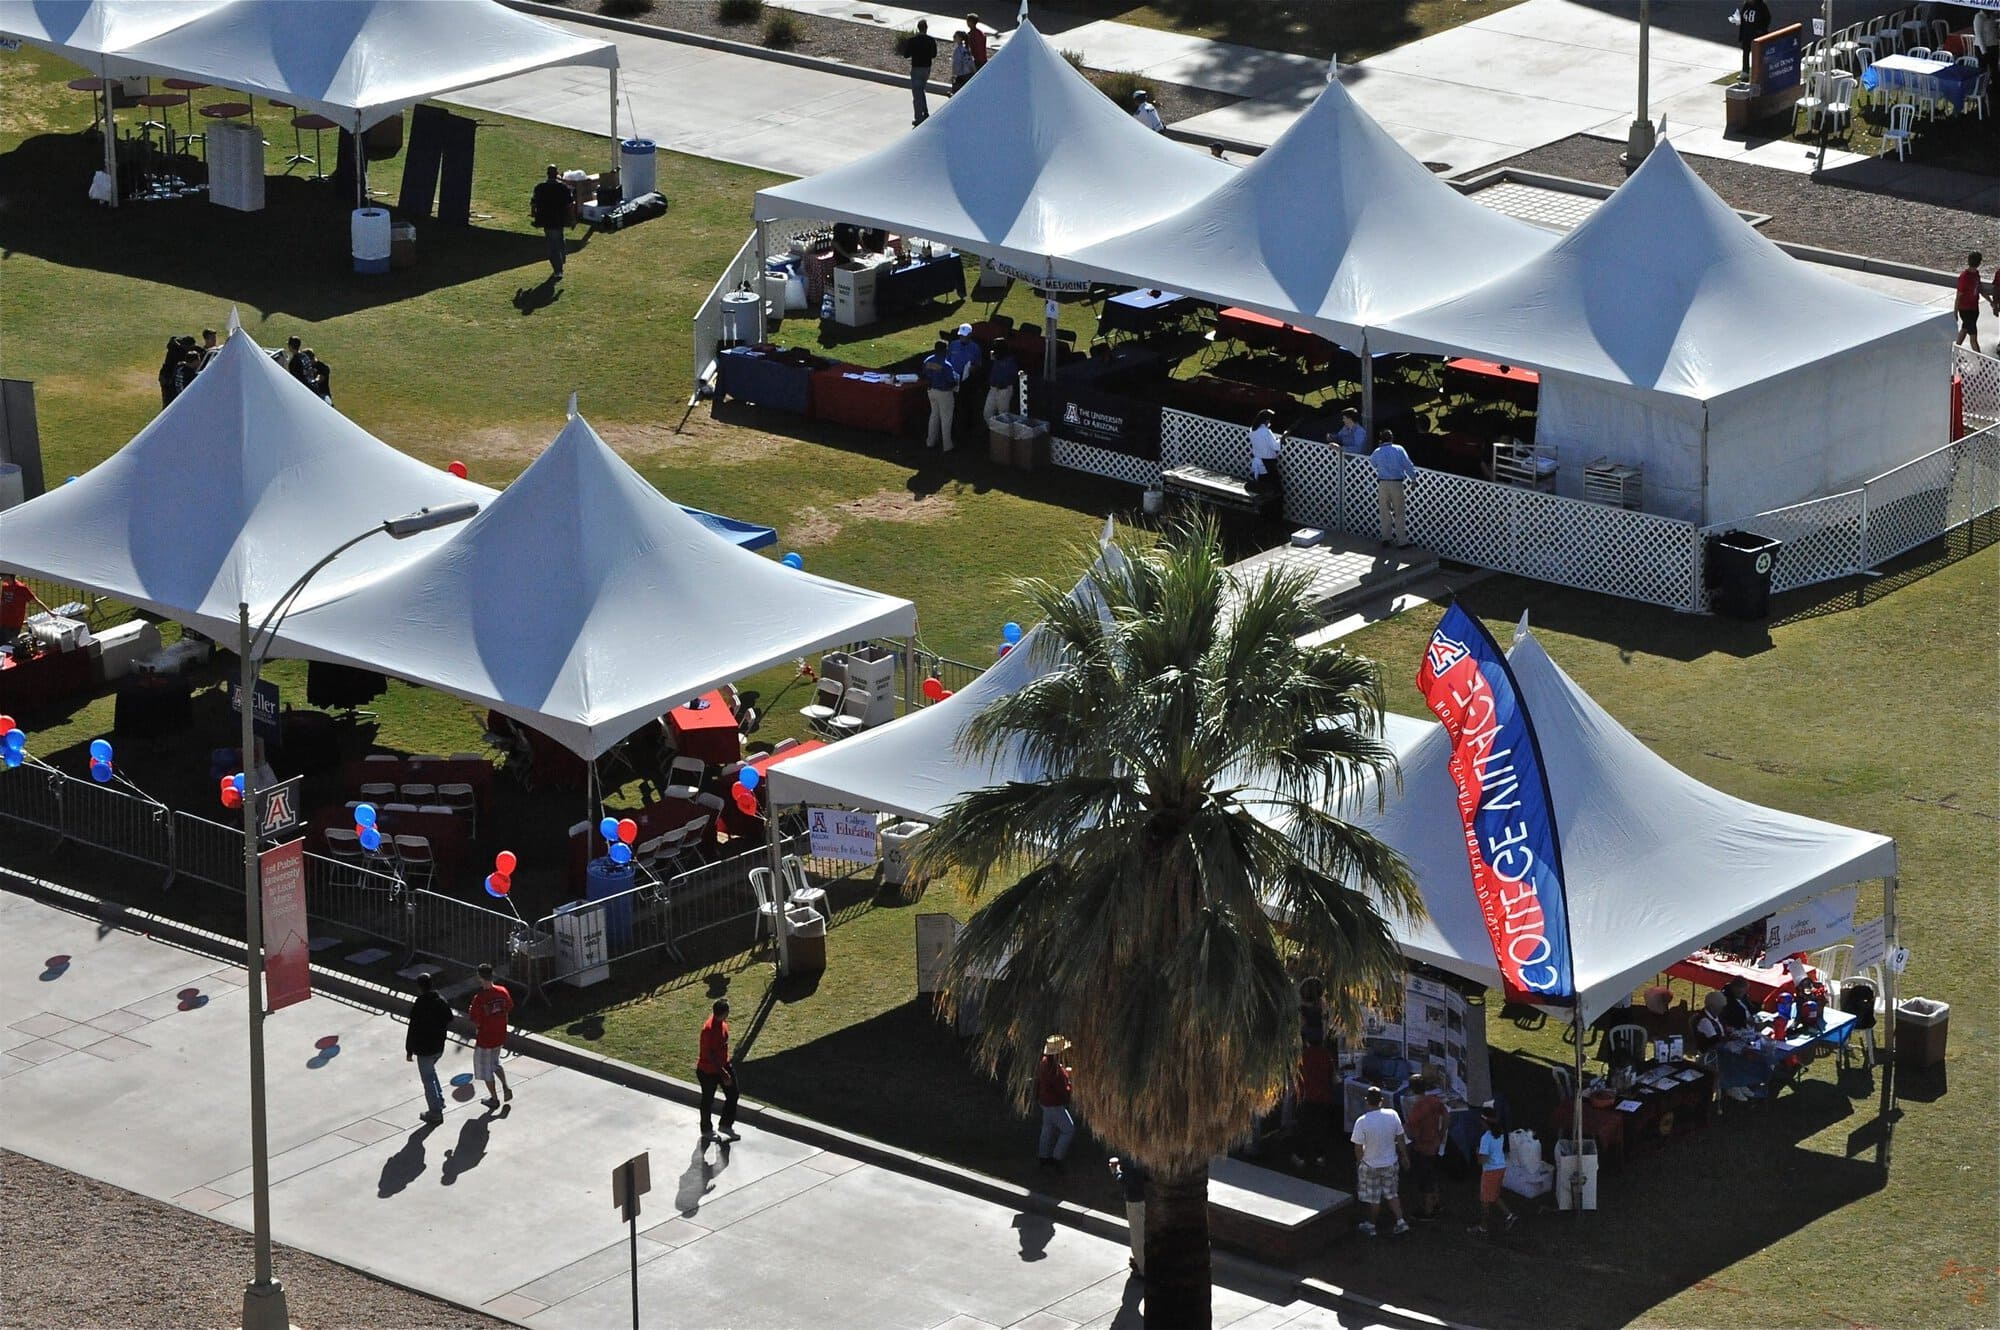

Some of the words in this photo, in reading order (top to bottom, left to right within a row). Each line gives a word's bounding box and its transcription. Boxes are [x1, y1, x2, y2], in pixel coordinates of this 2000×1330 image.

[1743, 10, 1756, 23] 48
[1046, 280, 1088, 290] MEDICINE
[1428, 629, 1470, 678] A
[261, 786, 296, 836] A
[812, 812, 828, 832] A
[836, 822, 877, 841] Education
[277, 856, 300, 871] Public
